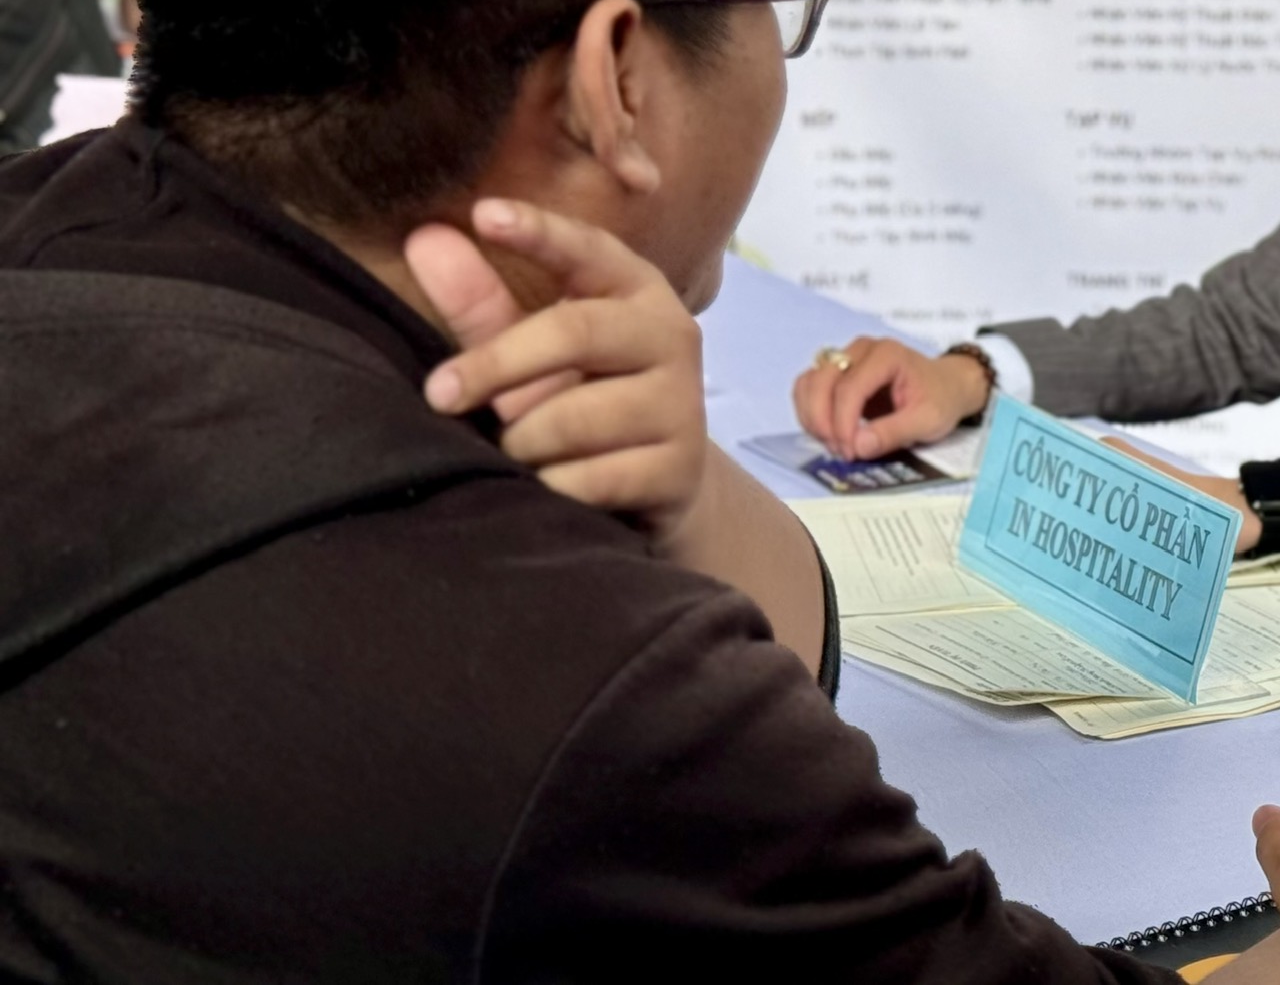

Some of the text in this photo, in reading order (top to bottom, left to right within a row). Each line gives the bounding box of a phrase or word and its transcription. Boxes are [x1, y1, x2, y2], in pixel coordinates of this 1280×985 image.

[1007, 497, 1183, 621] IN HOSPITALITY
[1013, 436, 1211, 570] CÔNG TY CỔ PHẦN
